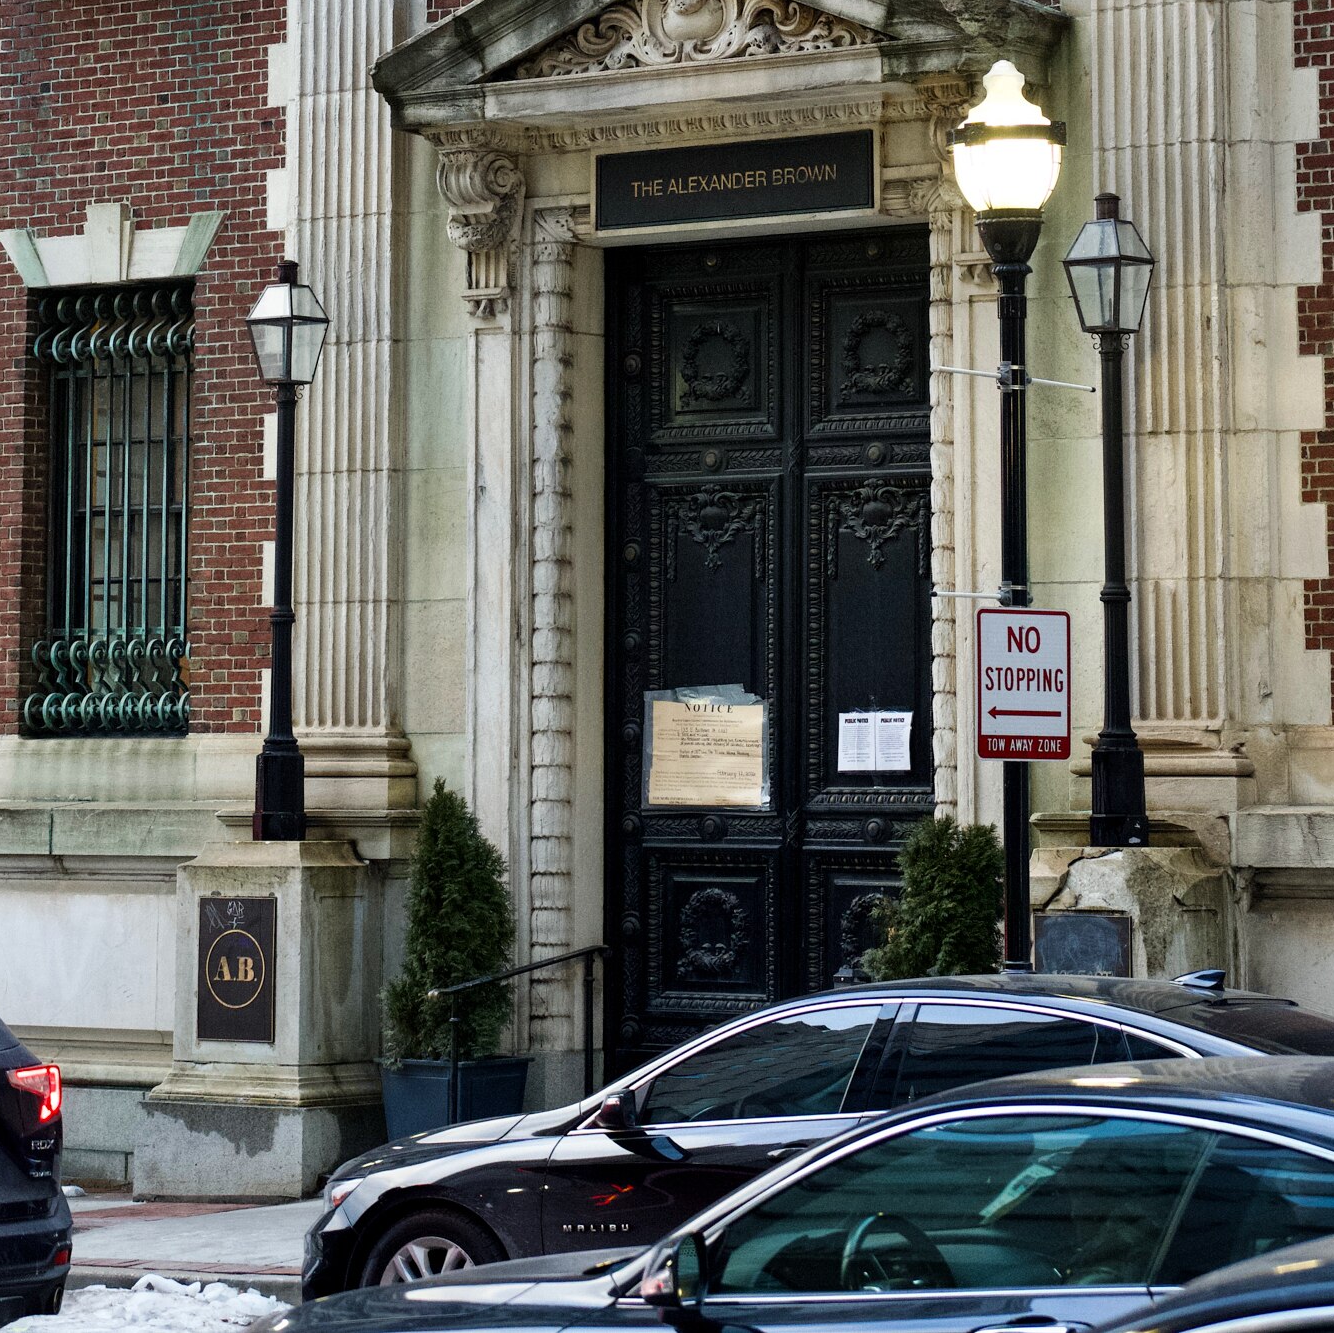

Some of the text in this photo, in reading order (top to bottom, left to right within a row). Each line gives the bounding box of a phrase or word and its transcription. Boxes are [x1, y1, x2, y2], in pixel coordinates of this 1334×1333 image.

[631, 164, 837, 198] THE ALEXANDER BROWN
[1007, 626, 1041, 654] NO
[985, 667, 1064, 693] STOPPING
[684, 703, 734, 714] NOTICE
[987, 738, 1062, 753] TOW AWAY ZONE
[213, 955, 257, 982] A.B.
[31, 1139, 55, 1150] RDX
[562, 1223, 629, 1232] MALIBU
